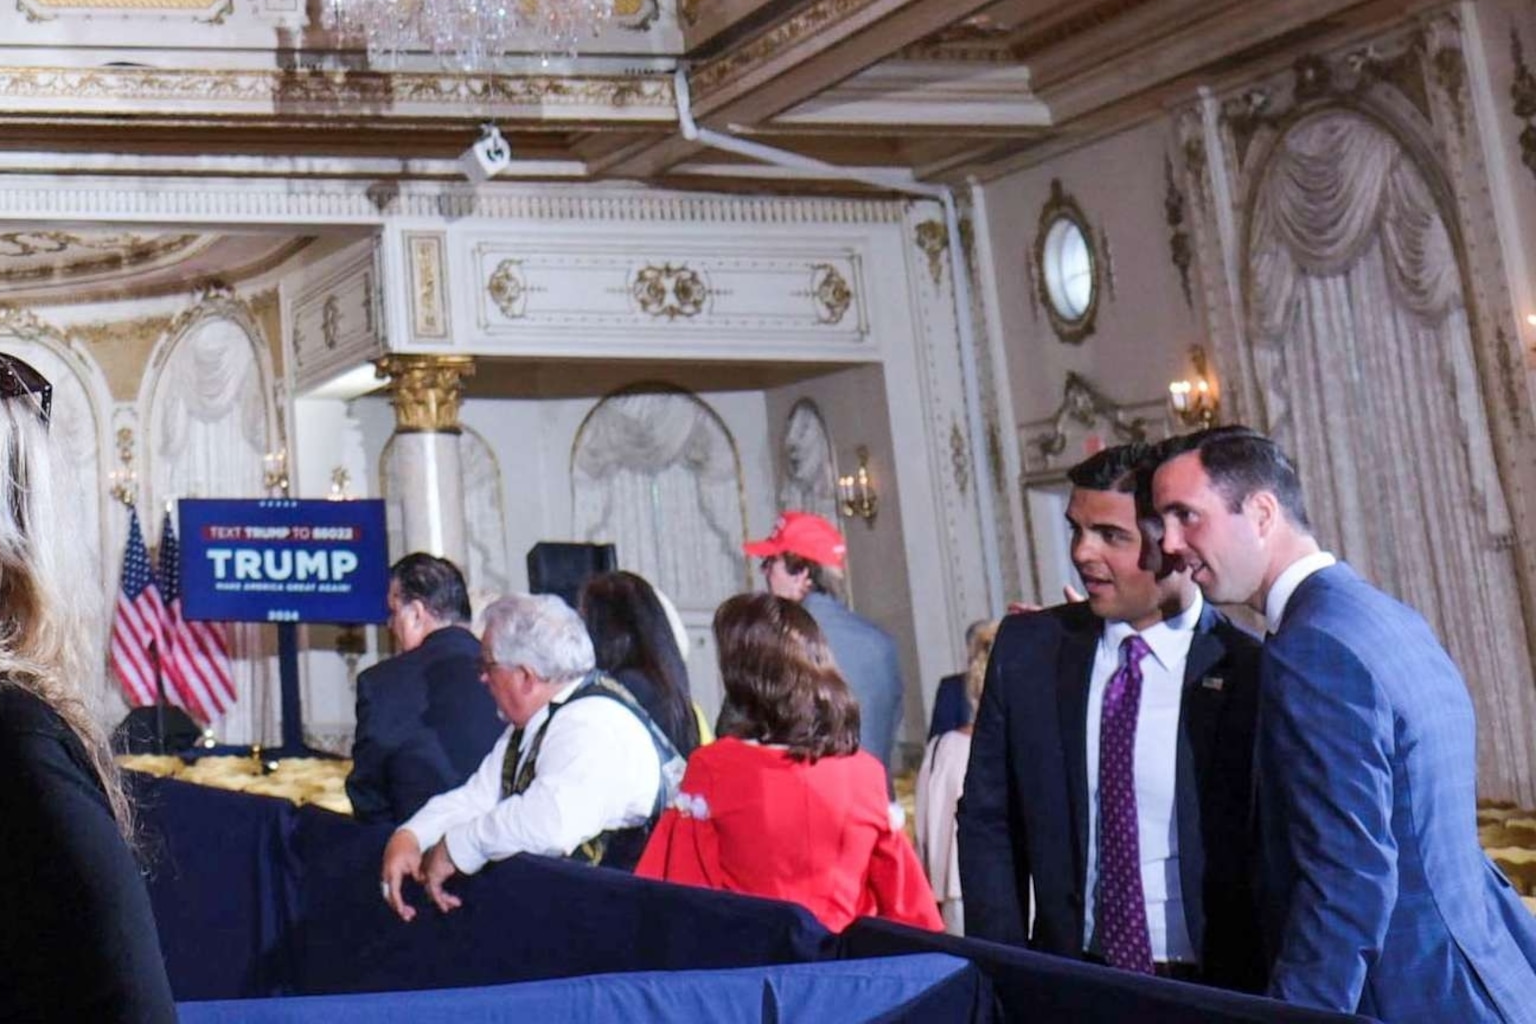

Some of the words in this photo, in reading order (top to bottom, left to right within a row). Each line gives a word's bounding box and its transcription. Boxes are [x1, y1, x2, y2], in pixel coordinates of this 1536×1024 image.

[210, 526, 241, 540] TEXT
[245, 526, 291, 540] TRUMP
[292, 526, 310, 541] TO
[206, 548, 359, 581] TRUMP
